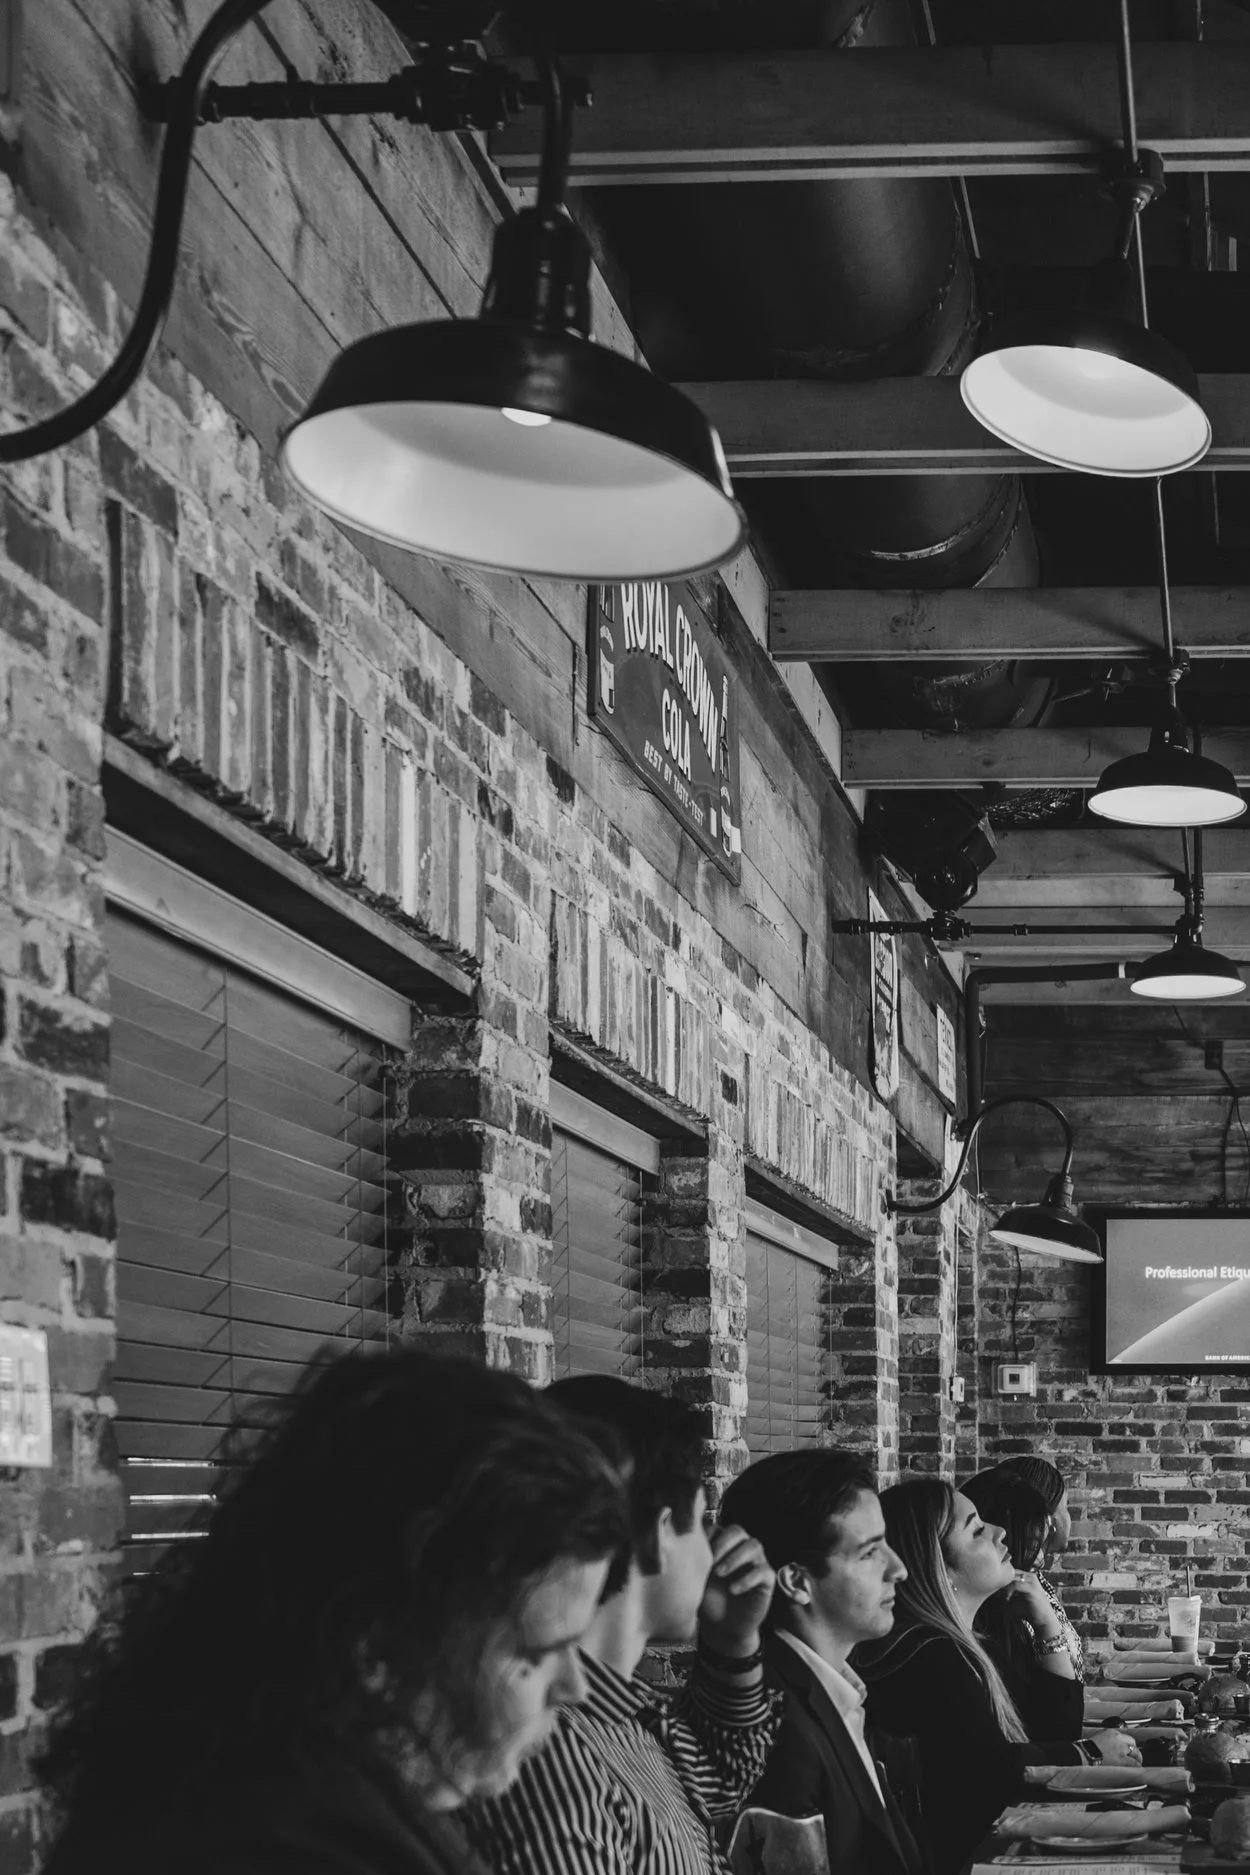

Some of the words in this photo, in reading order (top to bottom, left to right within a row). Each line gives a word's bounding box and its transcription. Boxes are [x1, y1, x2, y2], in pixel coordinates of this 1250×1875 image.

[620, 582, 674, 669] ROYAL
[676, 604, 719, 774] CROWN
[661, 688, 692, 782] COLA
[643, 739, 662, 773] BEST
[664, 763, 672, 786] BY
[673, 773, 704, 827] TASTE-TEST
[1145, 1266, 1217, 1279] Professional
